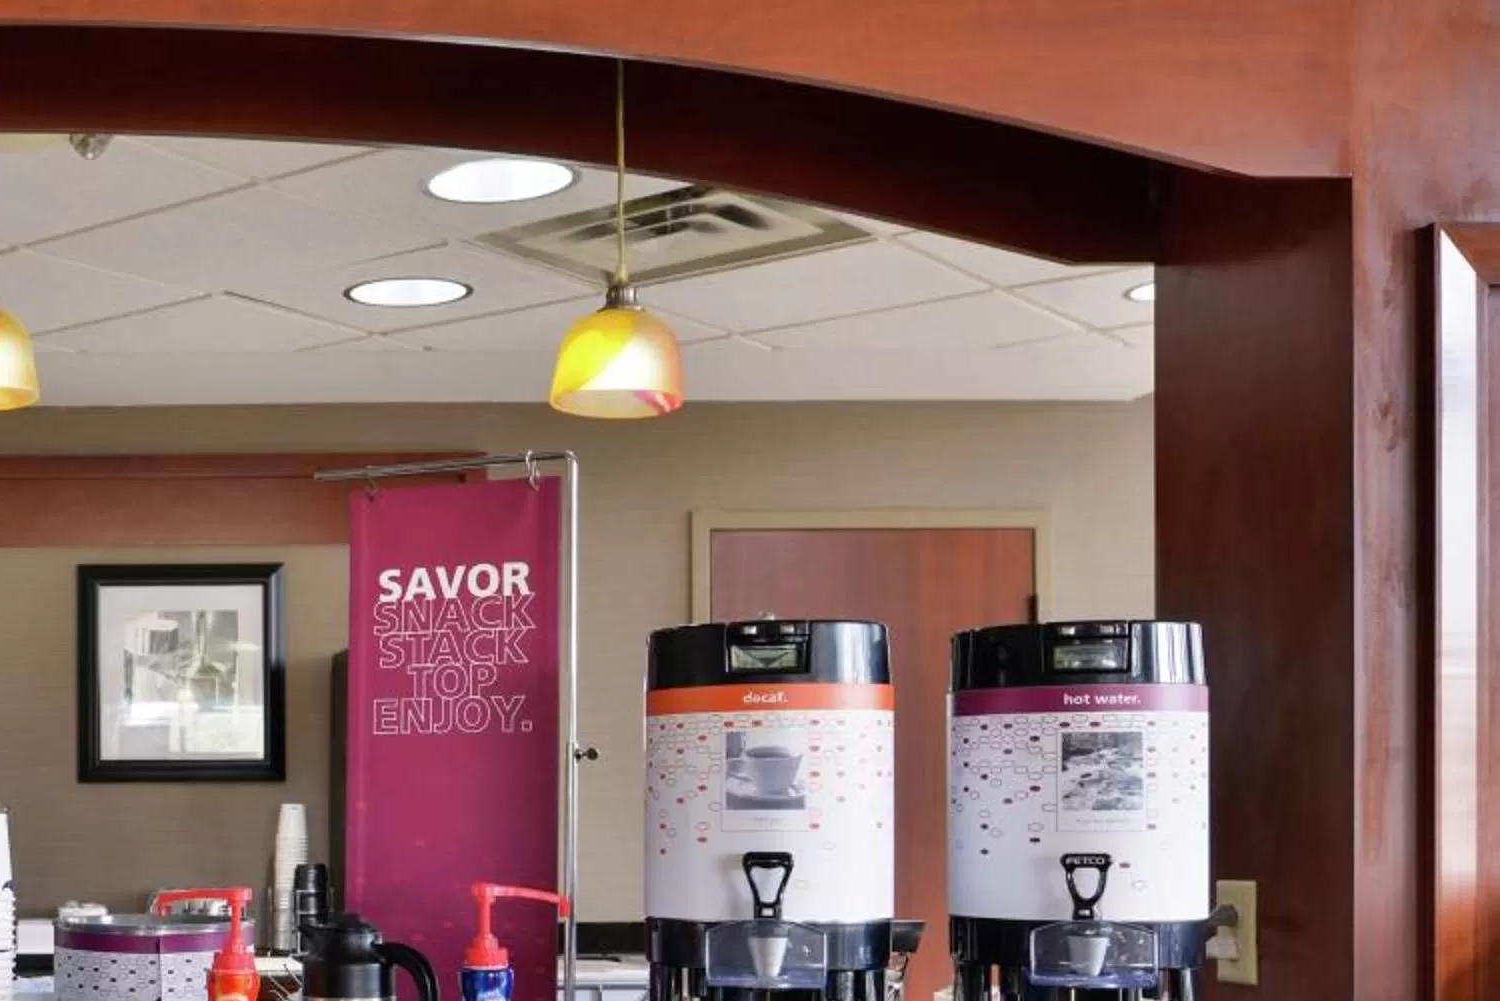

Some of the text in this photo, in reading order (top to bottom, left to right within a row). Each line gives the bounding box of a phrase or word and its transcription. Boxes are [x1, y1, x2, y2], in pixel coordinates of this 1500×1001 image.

[378, 561, 531, 602] SAVOR
[373, 592, 537, 636] SNACK
[378, 628, 529, 669] STACK
[407, 662, 498, 701] TOP
[743, 690, 789, 704] decaf.
[1063, 692, 1141, 705] hot water.
[372, 695, 533, 736] ENJOY.
